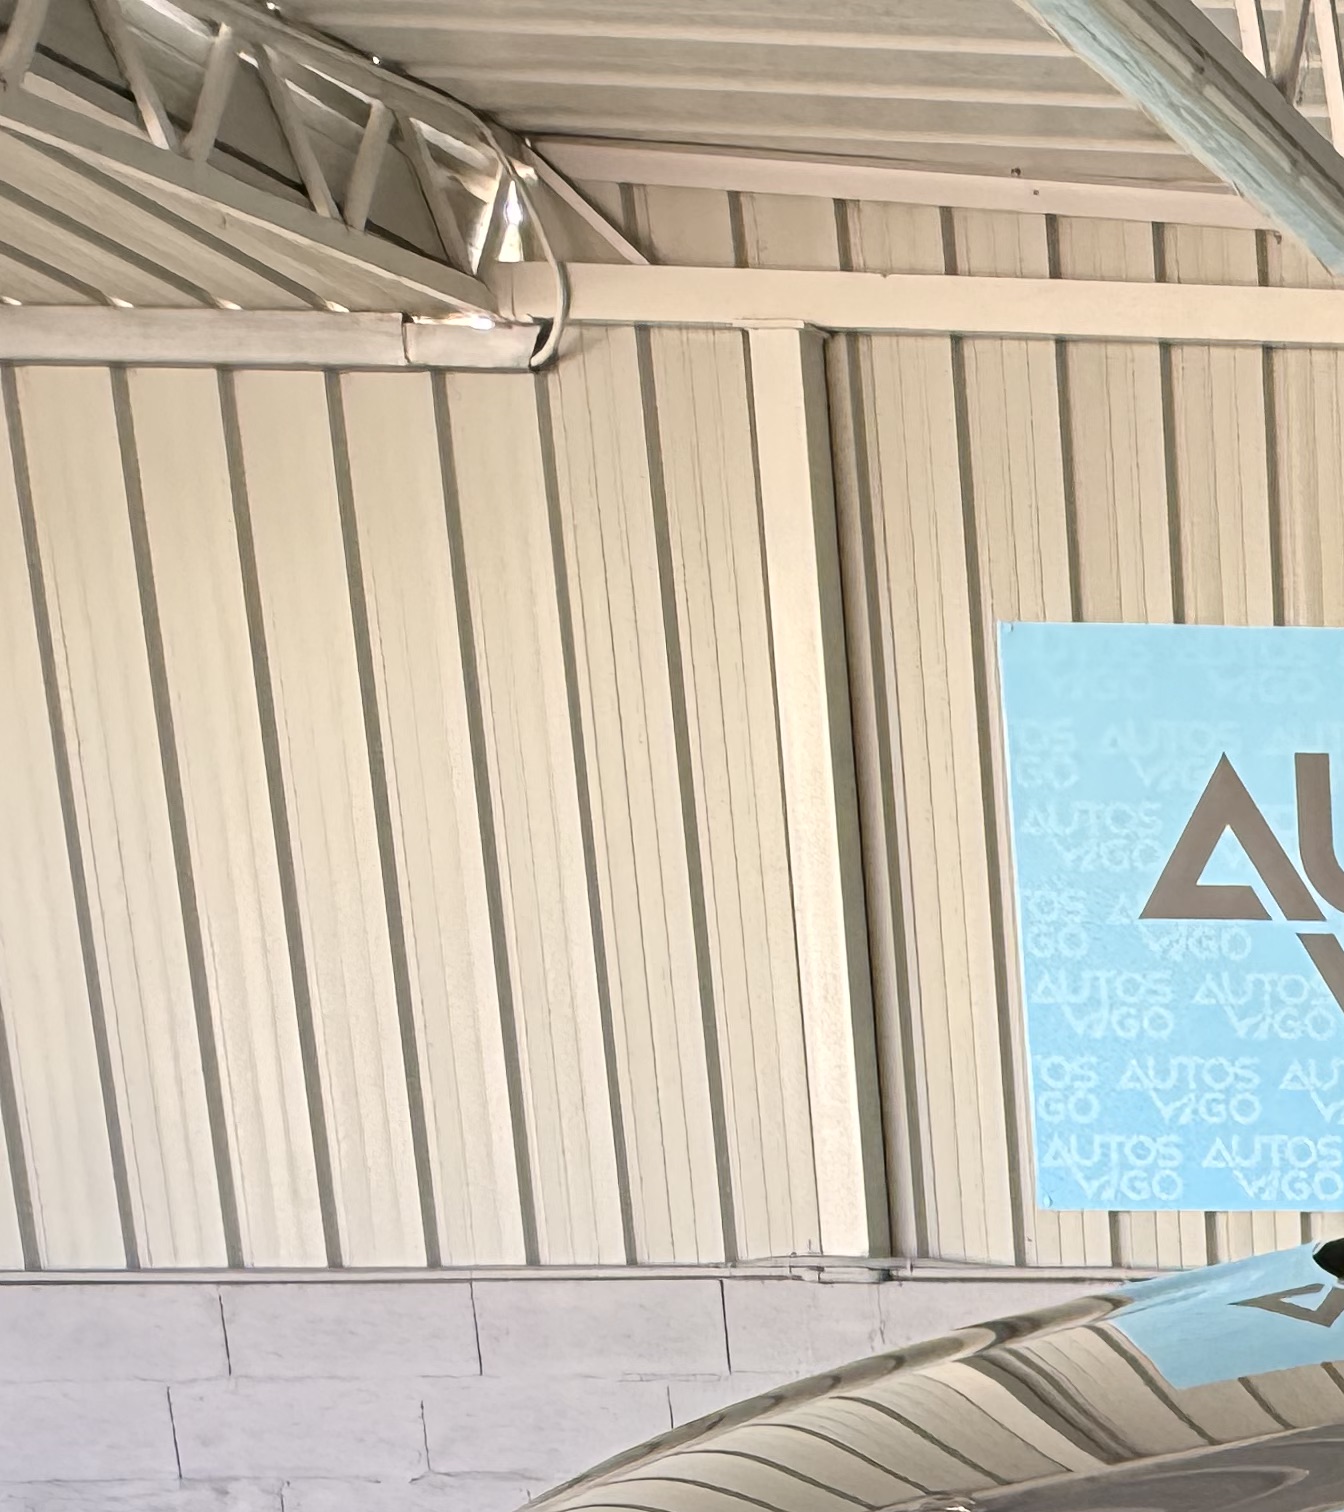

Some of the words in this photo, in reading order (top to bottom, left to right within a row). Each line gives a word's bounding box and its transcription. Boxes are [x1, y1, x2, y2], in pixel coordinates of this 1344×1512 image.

[1021, 800, 1163, 835] AUTOS
[1033, 970, 1174, 1005] AUTOS
[1191, 971, 1334, 1006] AUTOS
[1060, 1005, 1174, 1040] VIGO
[1221, 1006, 1336, 1041] VIGO
[1117, 1055, 1261, 1090] AUTOS
[1149, 1090, 1262, 1126] VIGO
[1041, 1133, 1184, 1169] AUTOS
[1200, 1134, 1343, 1170] AUTOS
[1066, 1167, 1184, 1202] VIGO
[1230, 1168, 1344, 1202] VIGO
